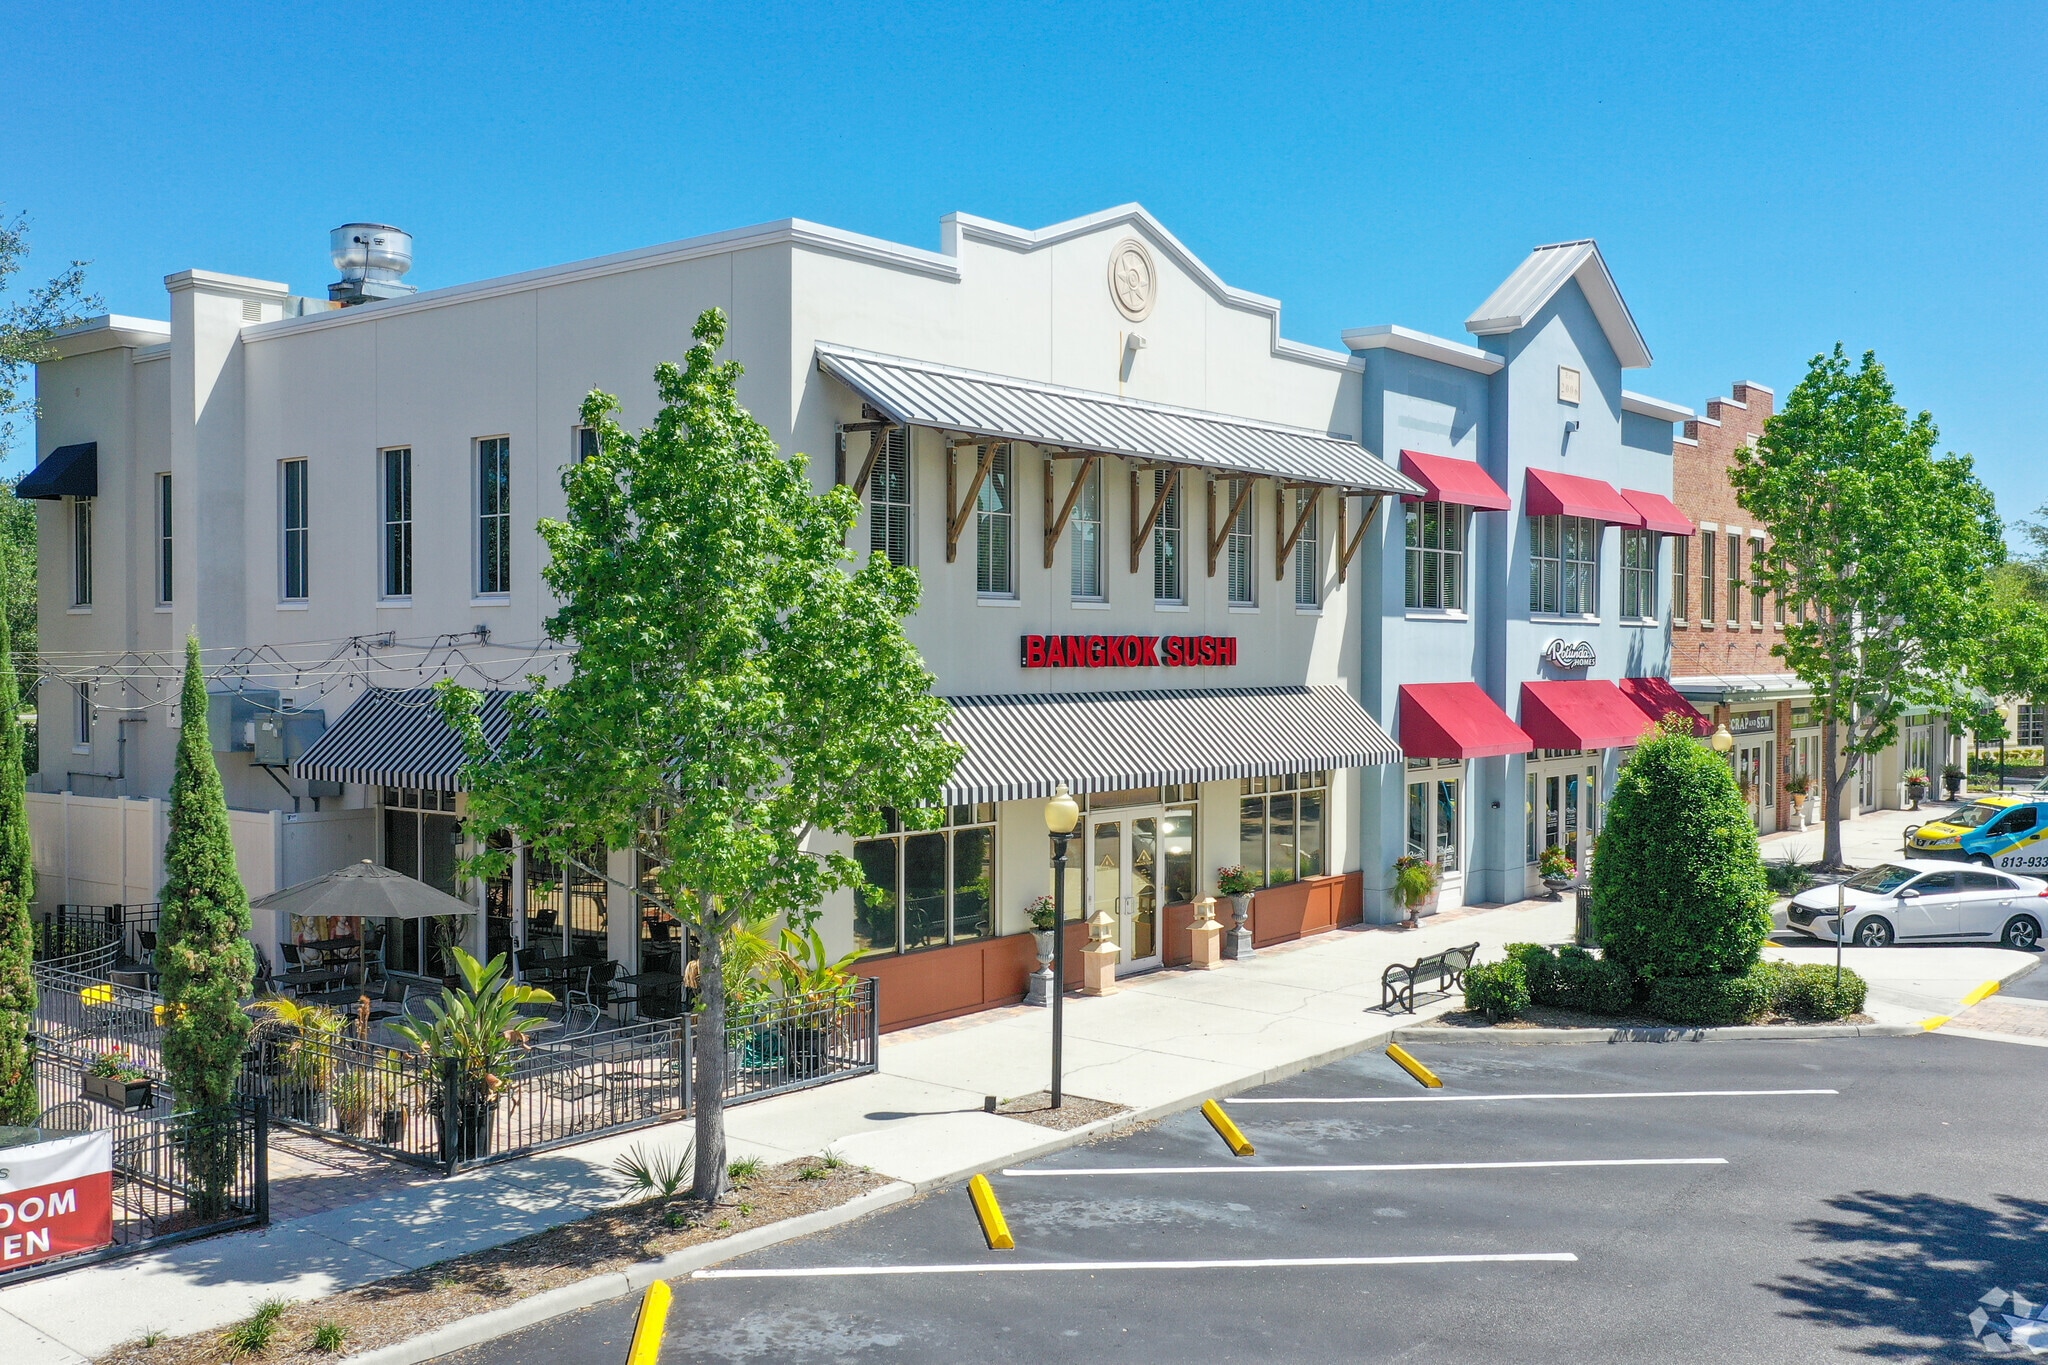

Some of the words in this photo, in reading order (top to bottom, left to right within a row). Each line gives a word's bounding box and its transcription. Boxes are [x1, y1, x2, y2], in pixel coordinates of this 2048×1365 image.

[1021, 634, 1160, 668] BANGKOK
[1161, 635, 1237, 667] SUSHI
[1573, 658, 1596, 667] HOMES
[1730, 717, 1749, 730] CRAP
[1756, 715, 1771, 729] SEW
